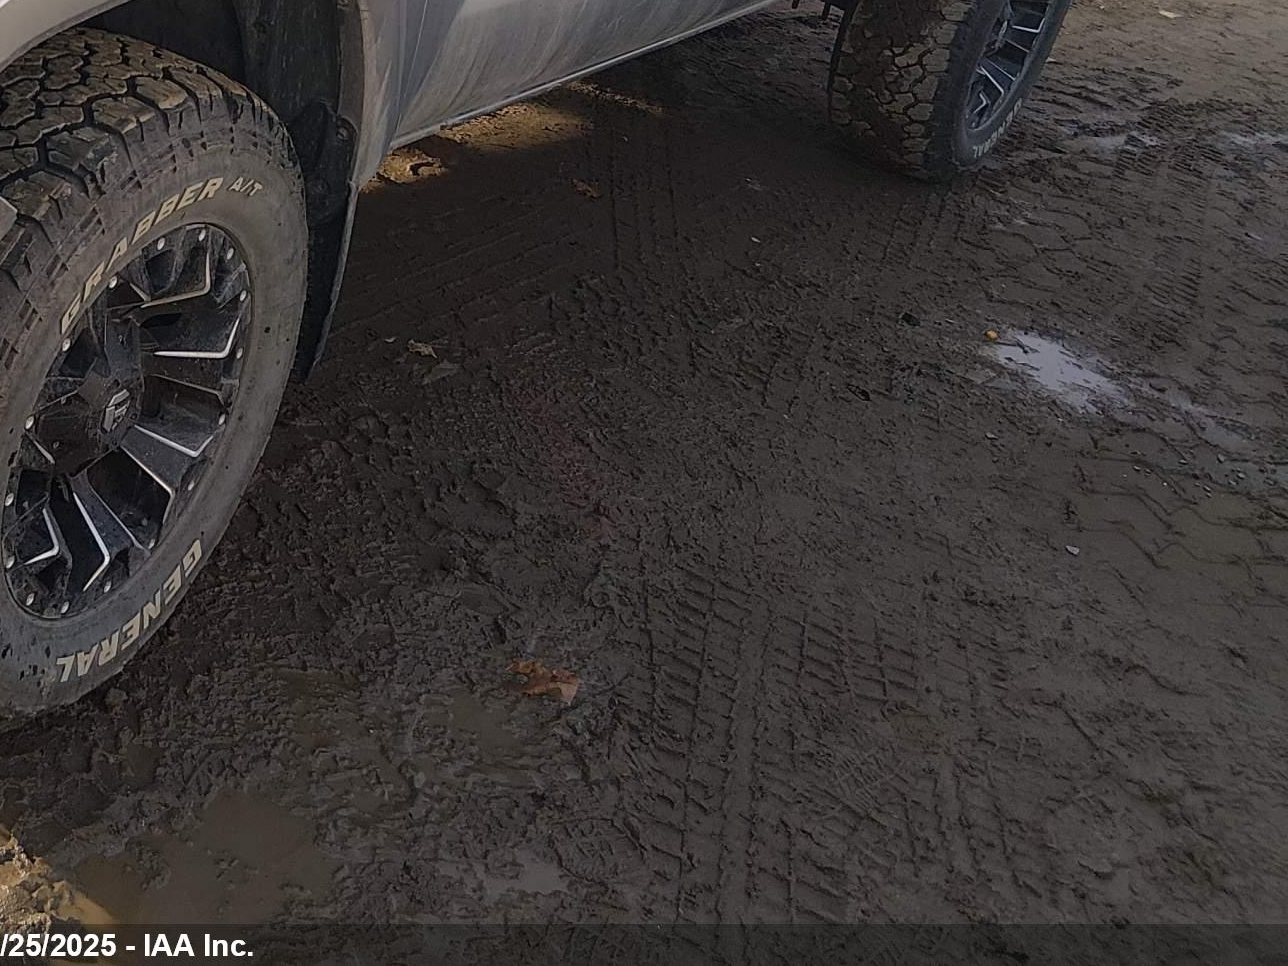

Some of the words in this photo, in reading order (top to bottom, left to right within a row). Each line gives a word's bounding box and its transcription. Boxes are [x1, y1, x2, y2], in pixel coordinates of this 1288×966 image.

[61, 176, 225, 335] GRABBER
[228, 176, 263, 198] A/T
[55, 538, 203, 684] GENERAL
